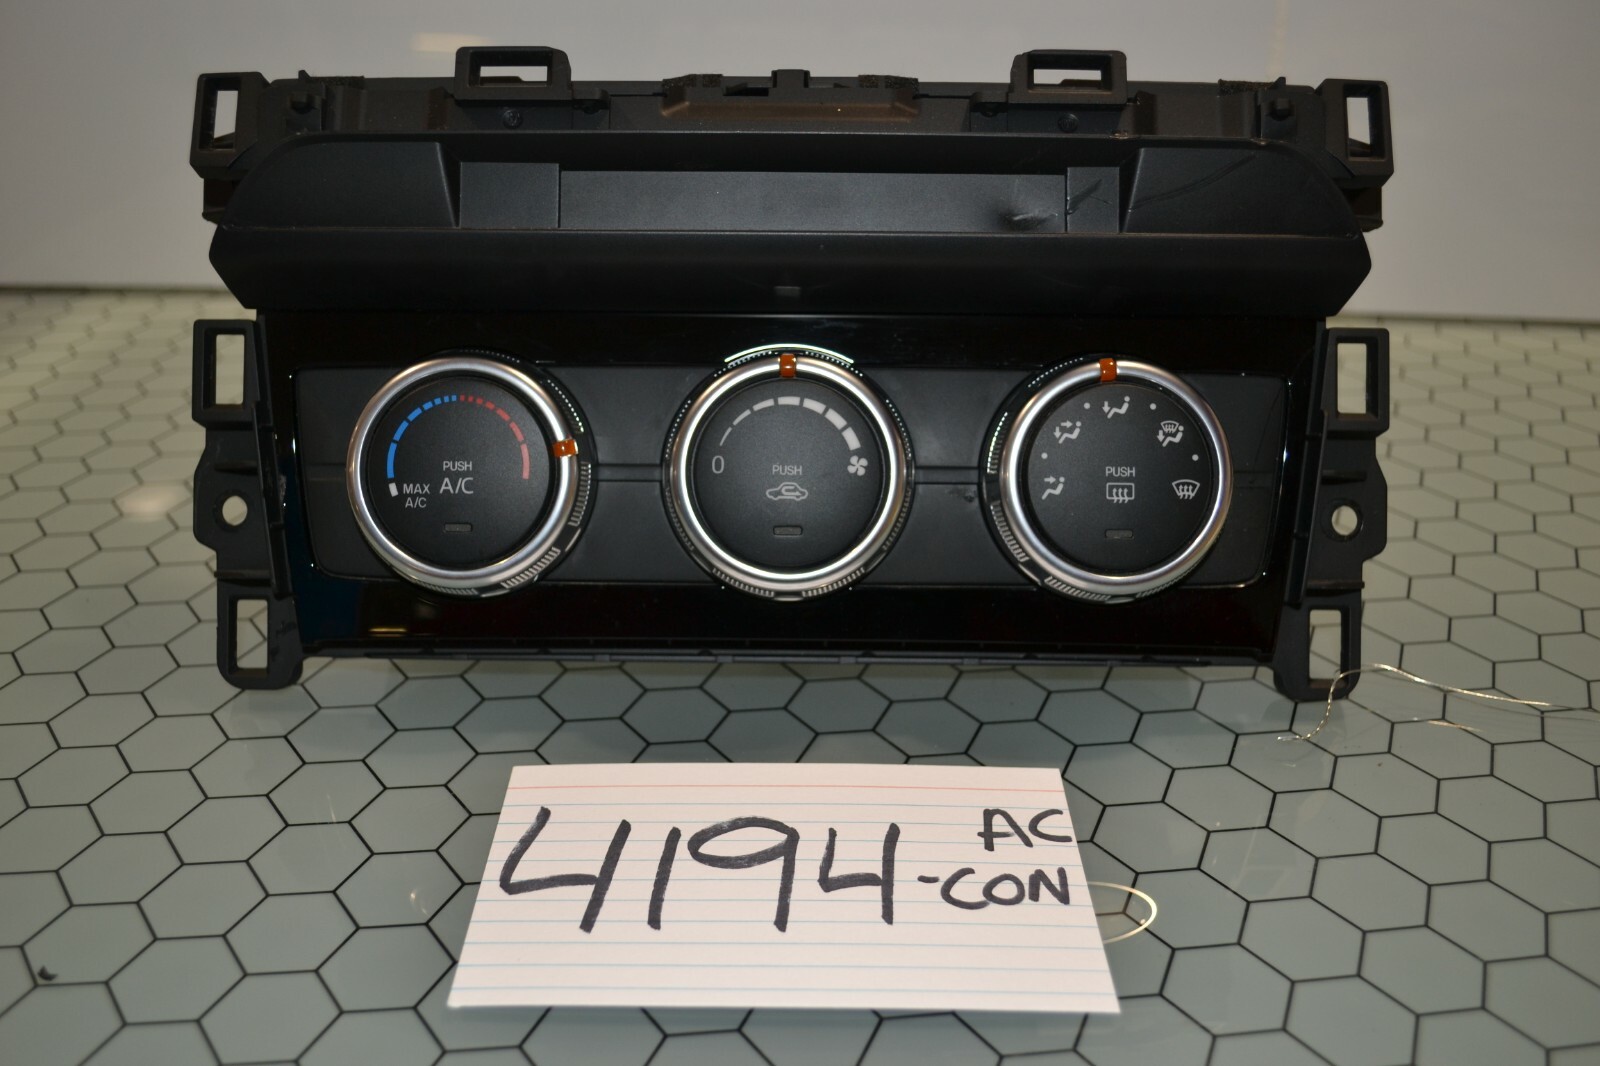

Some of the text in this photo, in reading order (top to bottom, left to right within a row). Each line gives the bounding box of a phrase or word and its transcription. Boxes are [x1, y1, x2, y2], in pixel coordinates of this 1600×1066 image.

[442, 460, 473, 472] PUSH
[772, 465, 803, 476] PUSH
[1105, 466, 1136, 477] PUSH
[402, 483, 431, 494] MAX
[439, 477, 474, 495] A/C
[405, 497, 427, 508] A/C
[977, 807, 1073, 851] AC
[499, 805, 901, 933] 4194
